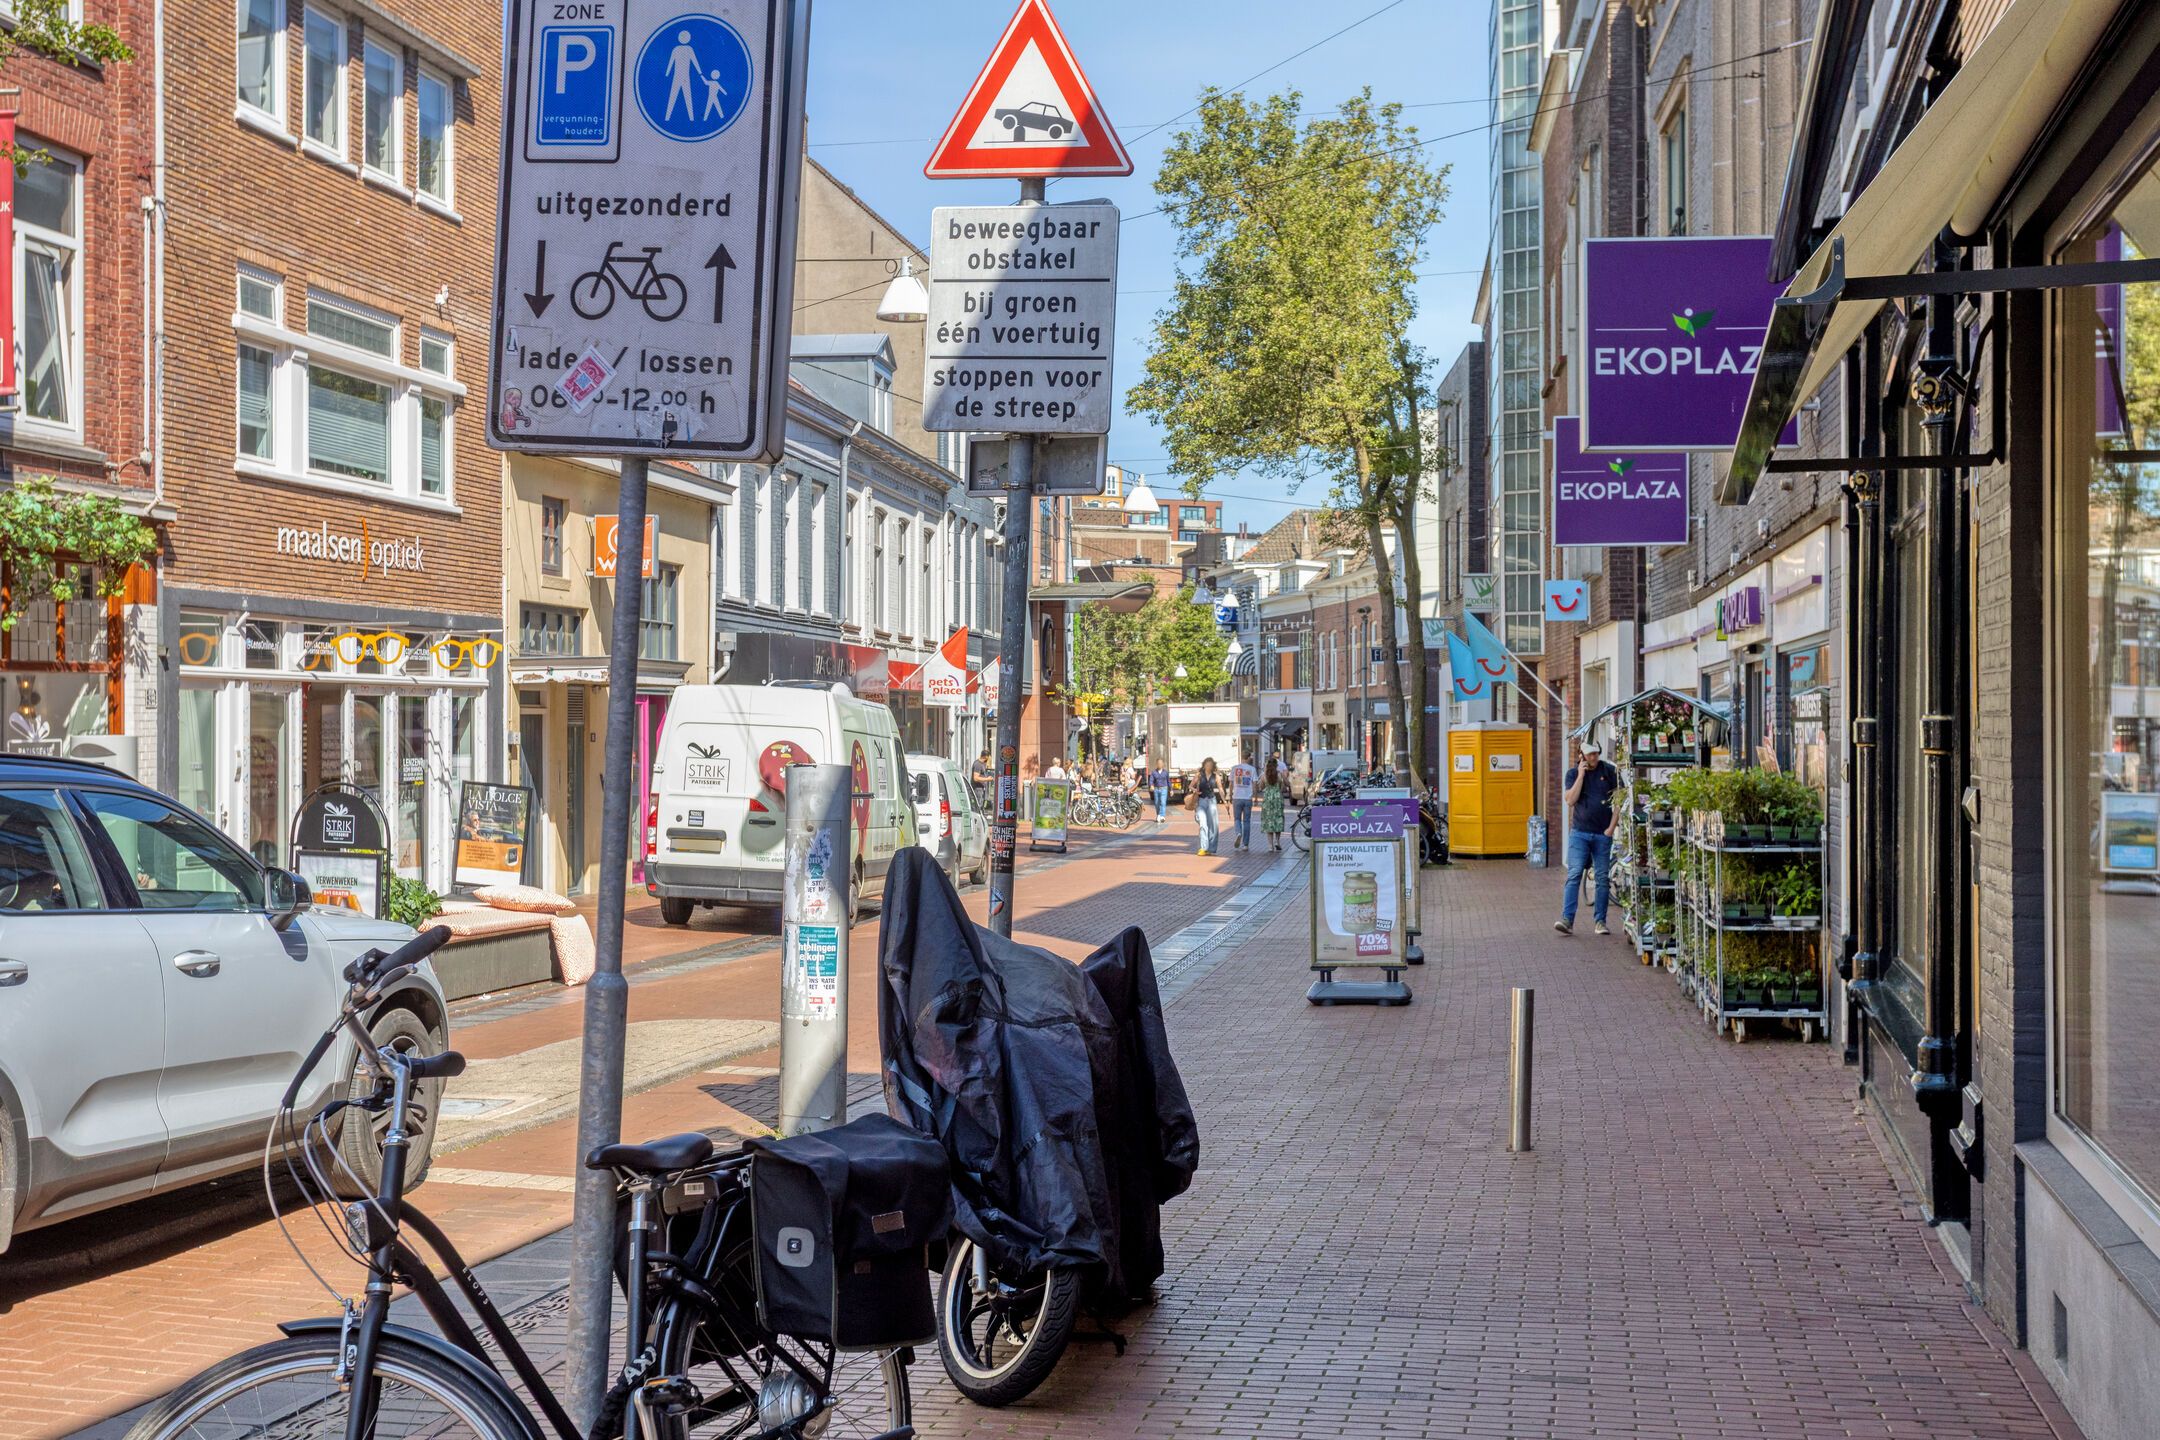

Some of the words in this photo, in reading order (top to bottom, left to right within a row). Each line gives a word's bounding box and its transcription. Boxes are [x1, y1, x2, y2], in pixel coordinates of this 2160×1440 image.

[553, 4, 605, 20] ZONE
[555, 34, 597, 95] P
[543, 115, 604, 124] vergunning-
[564, 127, 603, 135] houders
[536, 191, 731, 222] uitgezonderd
[948, 216, 1101, 246] beweegbaar
[967, 247, 1076, 270] obstakel
[963, 291, 994, 320] bij
[1004, 298, 1077, 320] groen
[936, 321, 981, 344] één
[992, 322, 1101, 351] voertuig
[519, 345, 578, 370] lade
[639, 348, 734, 376] lossen
[1595, 346, 1763, 376] EKOPLAZ
[933, 365, 1034, 392] stoppen
[1045, 369, 1102, 388] voor
[699, 390, 716, 414] h
[954, 395, 984, 418] de
[993, 398, 1077, 423] streep
[1560, 481, 1682, 501] EKOPLAZA
[276, 520, 362, 563] maalsen
[371, 535, 425, 578] optiek
[928, 677, 954, 688] pets
[932, 685, 963, 697] place
[688, 763, 726, 778] STRIK
[468, 788, 482, 801] LA
[468, 799, 498, 812] VISTA
[326, 819, 352, 831] STRIK
[1321, 822, 1394, 834] EKOPLAZA
[1327, 845, 1389, 853] TOPKWALITEIT
[1358, 933, 1388, 946] 70%
[462, 1266, 489, 1305] ELOPS
